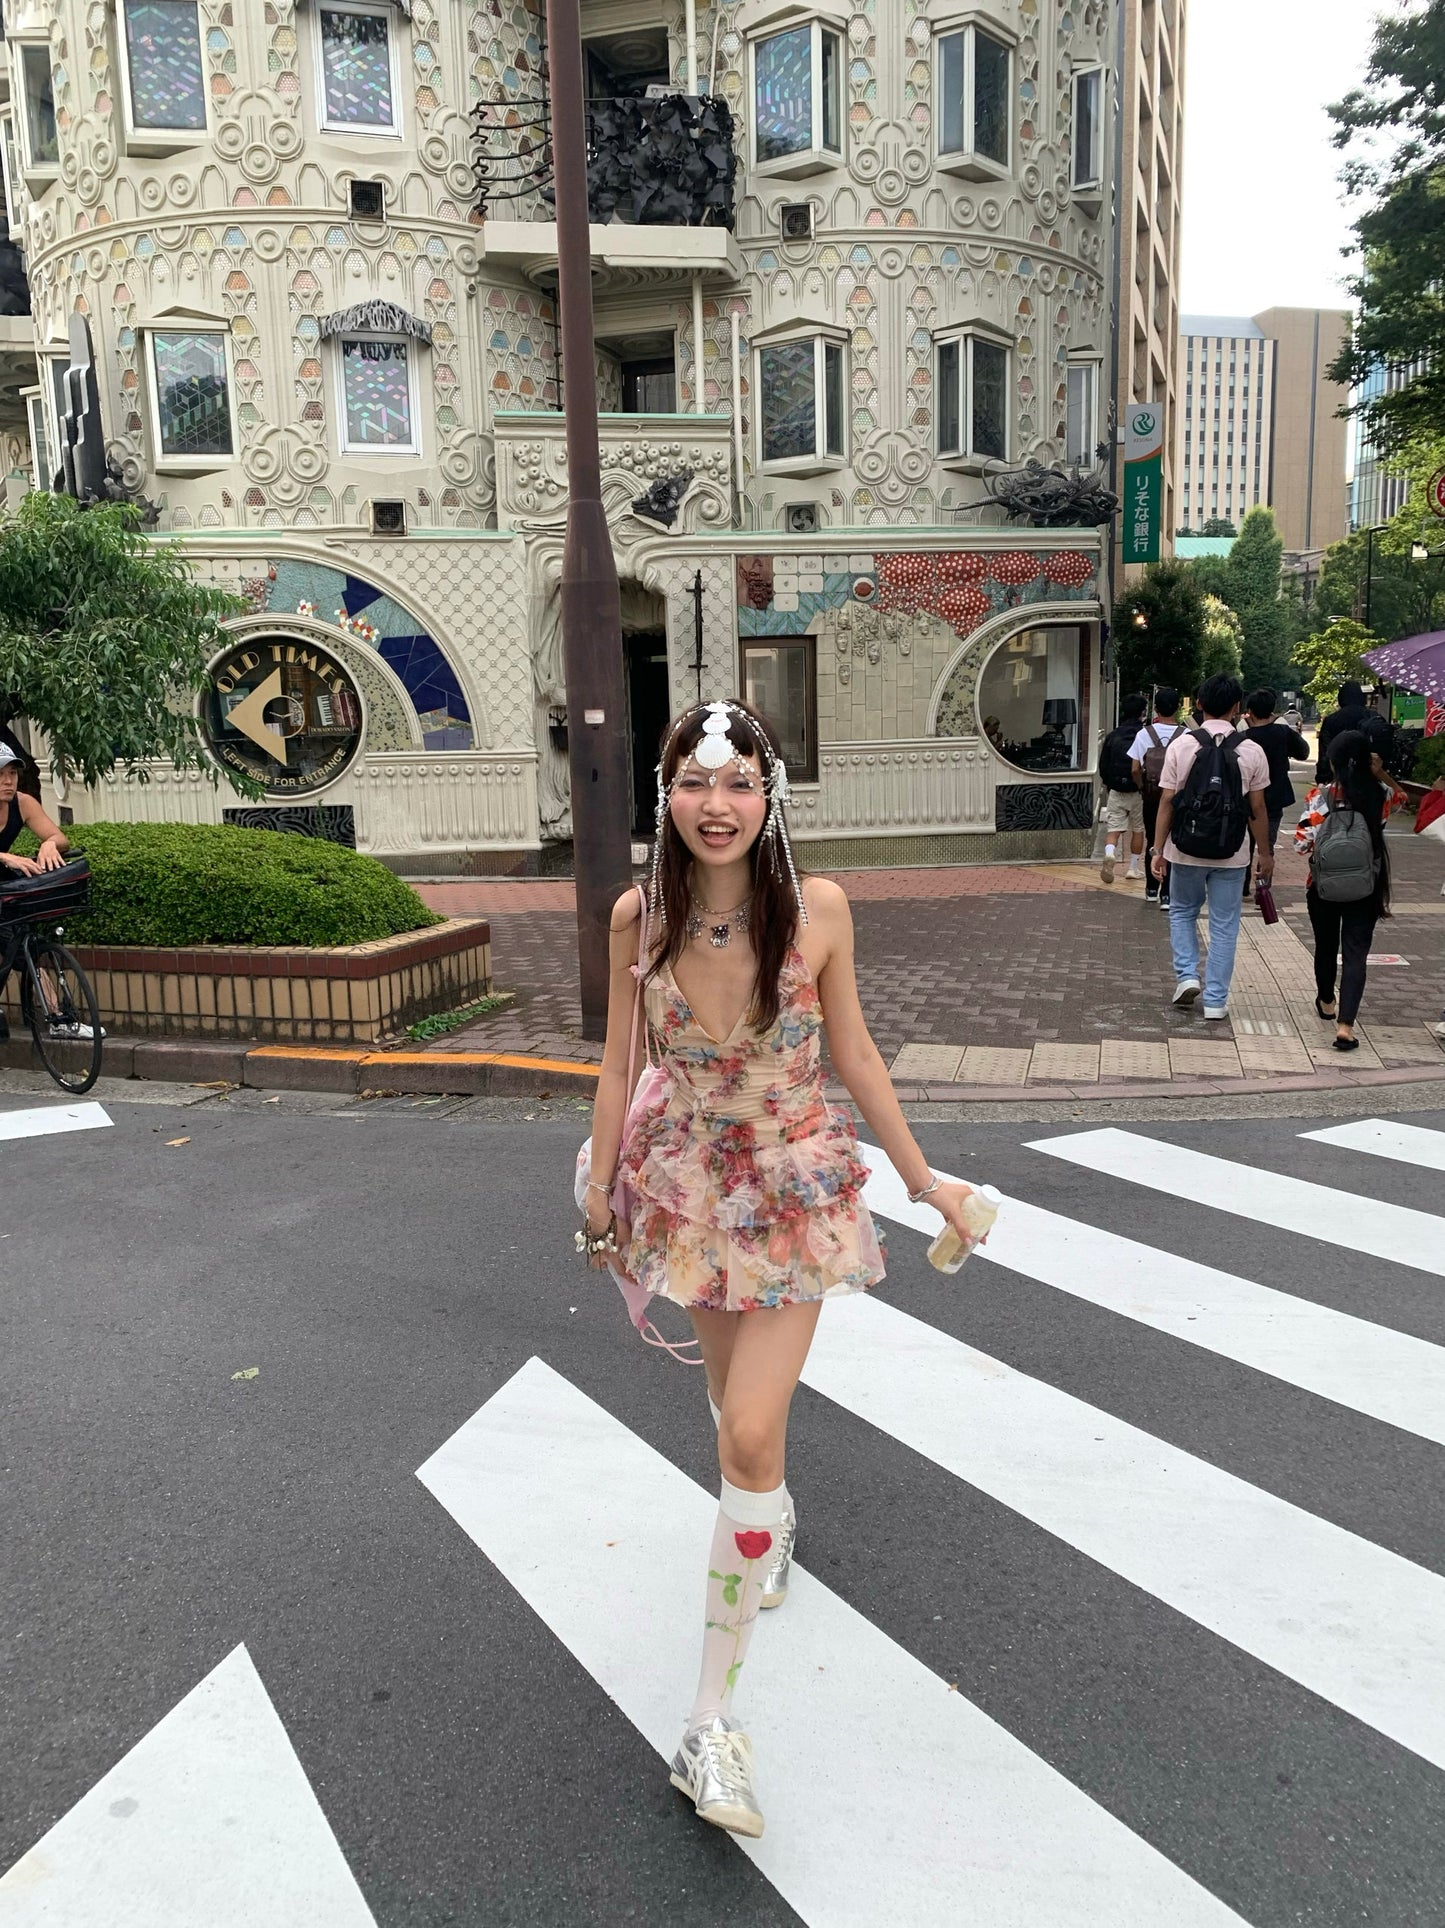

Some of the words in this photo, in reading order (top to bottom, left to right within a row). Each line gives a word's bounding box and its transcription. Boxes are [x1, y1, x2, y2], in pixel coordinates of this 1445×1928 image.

[1133, 475, 1150, 553] りそな銀行
[216, 651, 260, 694] OLD
[267, 645, 347, 694] TIMES
[222, 748, 247, 772] LEFT
[246, 768, 271, 785] SIDE
[274, 777, 296, 786] FOR
[298, 748, 347, 785] ENTRANCE
